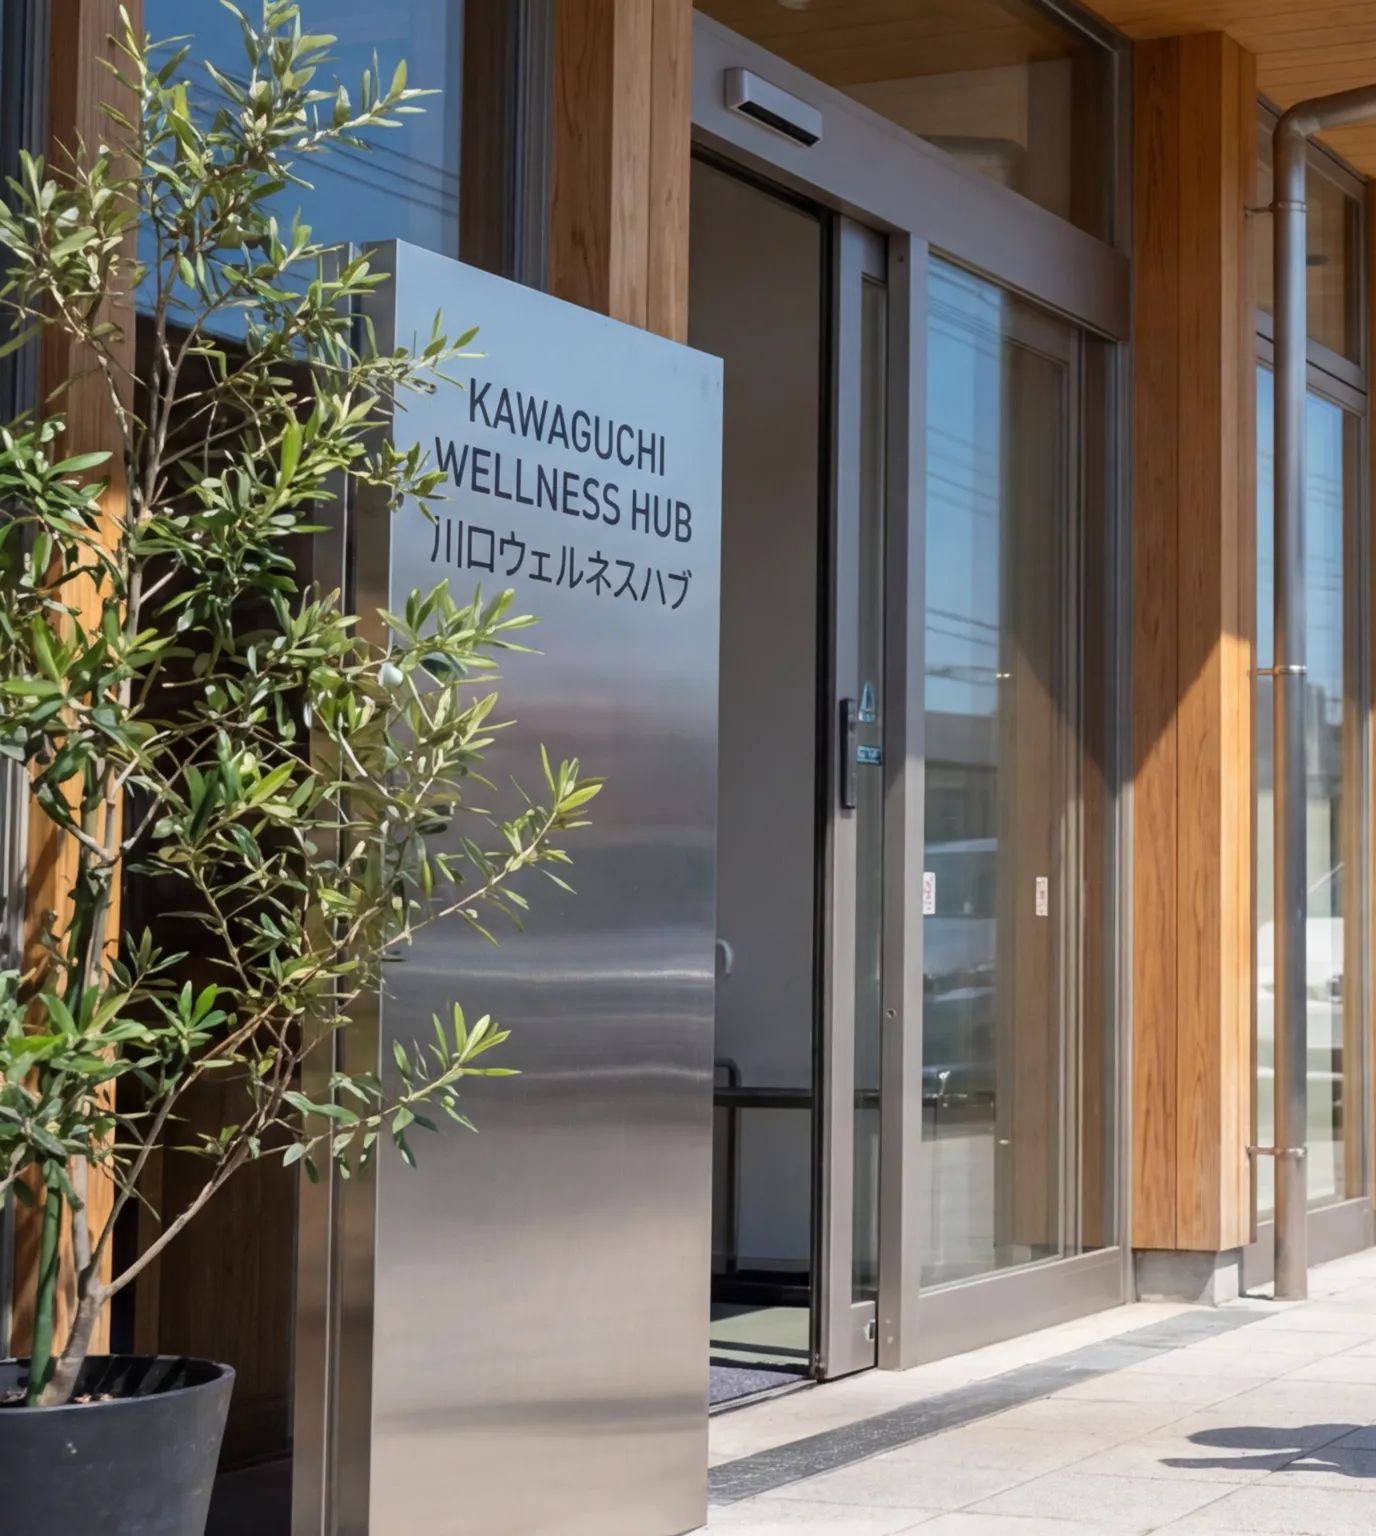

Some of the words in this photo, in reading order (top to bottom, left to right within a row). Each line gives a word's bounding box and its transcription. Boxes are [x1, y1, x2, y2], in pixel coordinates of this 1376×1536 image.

[469, 377, 665, 477] KAWAGUCHI
[435, 436, 621, 526] WELLNESS
[631, 489, 692, 543] HUB
[430, 515, 693, 610] 川口ウェルネスハブ
